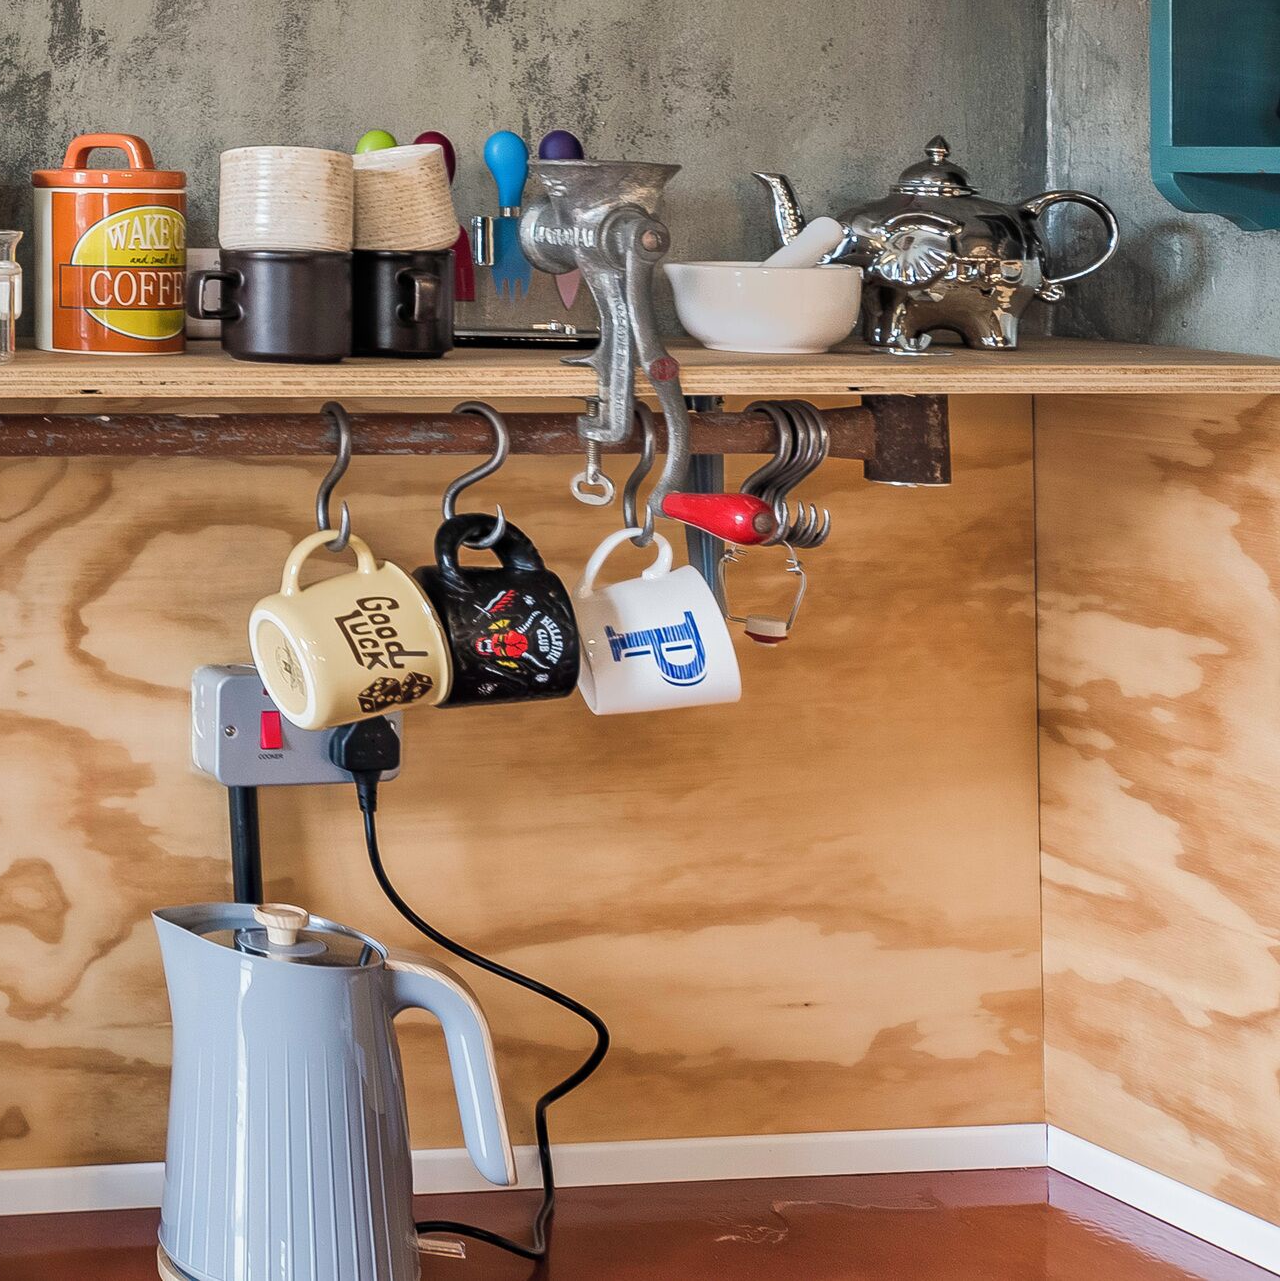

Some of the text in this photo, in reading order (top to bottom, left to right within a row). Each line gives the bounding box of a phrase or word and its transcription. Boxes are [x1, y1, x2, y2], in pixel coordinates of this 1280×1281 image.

[107, 214, 171, 251] WAKE
[130, 254, 149, 264] and
[151, 254, 167, 265] smell
[90, 270, 186, 307] COFFE
[356, 596, 429, 669] Good
[536, 628, 550, 653] CLUB
[540, 615, 564, 665] HELLFIRE
[604, 611, 707, 687] P
